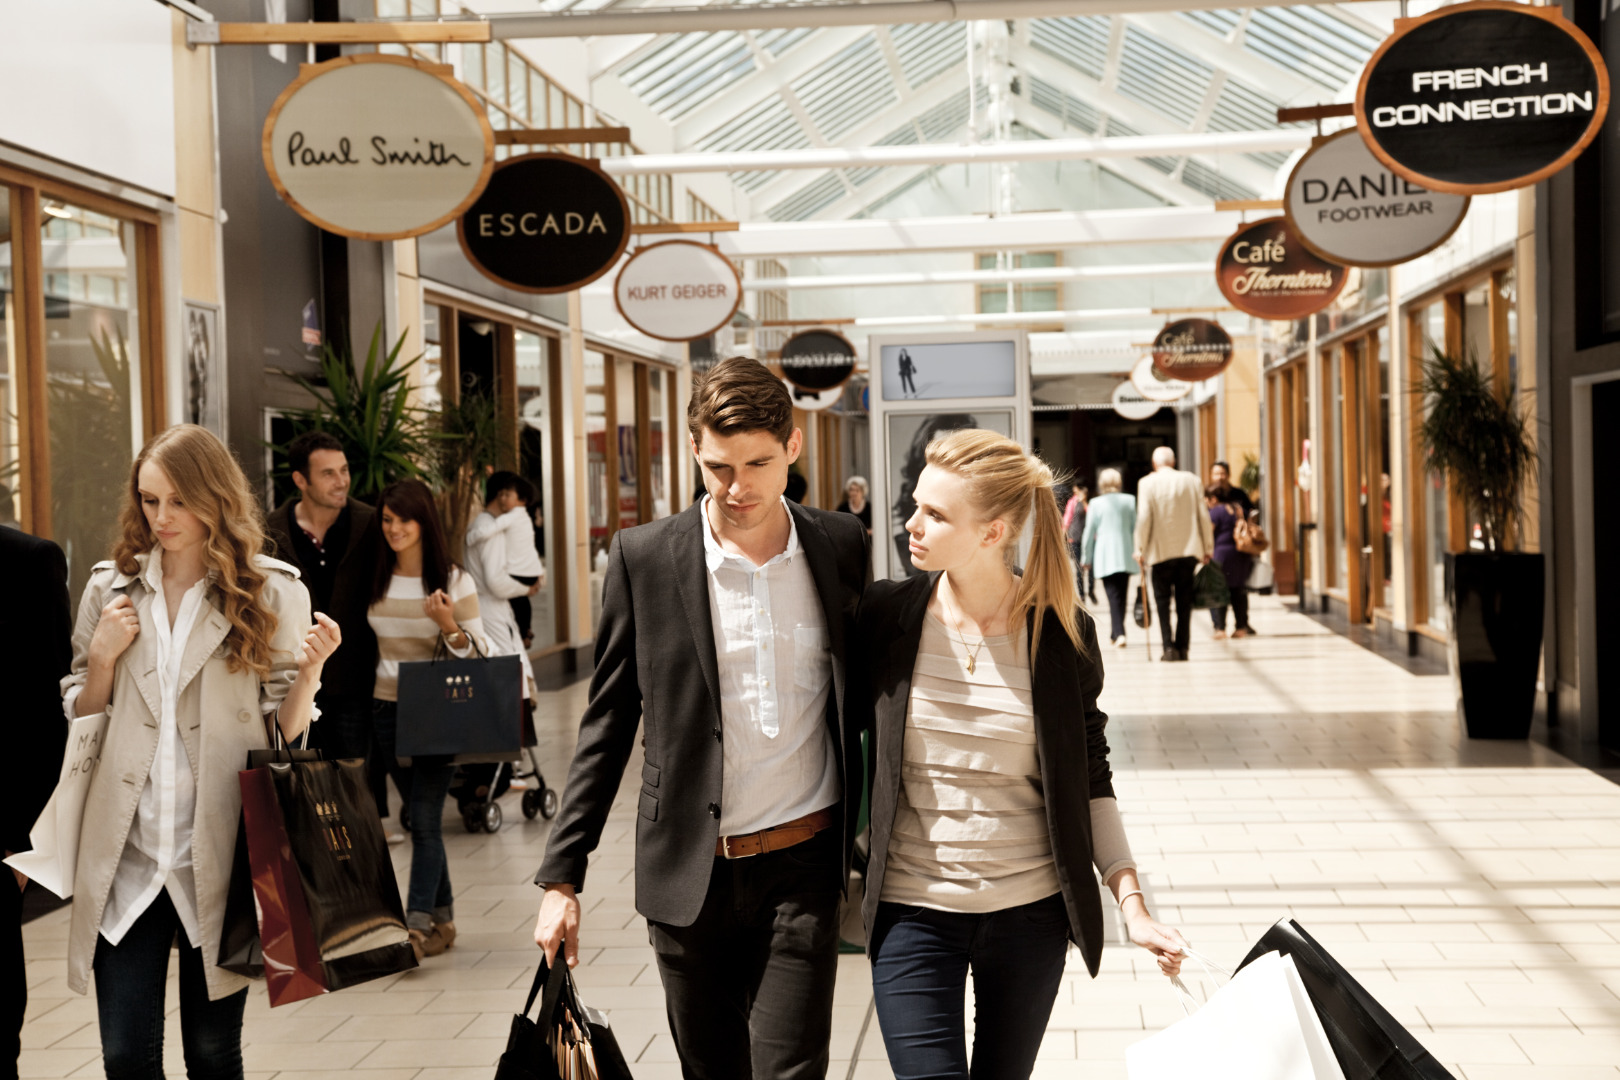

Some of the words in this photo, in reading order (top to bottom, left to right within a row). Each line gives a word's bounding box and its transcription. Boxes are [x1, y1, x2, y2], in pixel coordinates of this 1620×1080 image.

[1412, 62, 1549, 93] FRENCH
[1372, 90, 1593, 128] CONNECTION
[288, 131, 359, 167] Paul
[370, 135, 471, 167] Smith
[1302, 173, 1428, 204] DANIE
[479, 212, 607, 237] ESCADA
[1317, 200, 1434, 224] FOOTWEAR
[1232, 231, 1286, 264] Café
[627, 286, 667, 301] KURT
[671, 284, 727, 299] GEIGER
[1231, 266, 1333, 295] Thorntons
[1160, 350, 1224, 368] Thorntons
